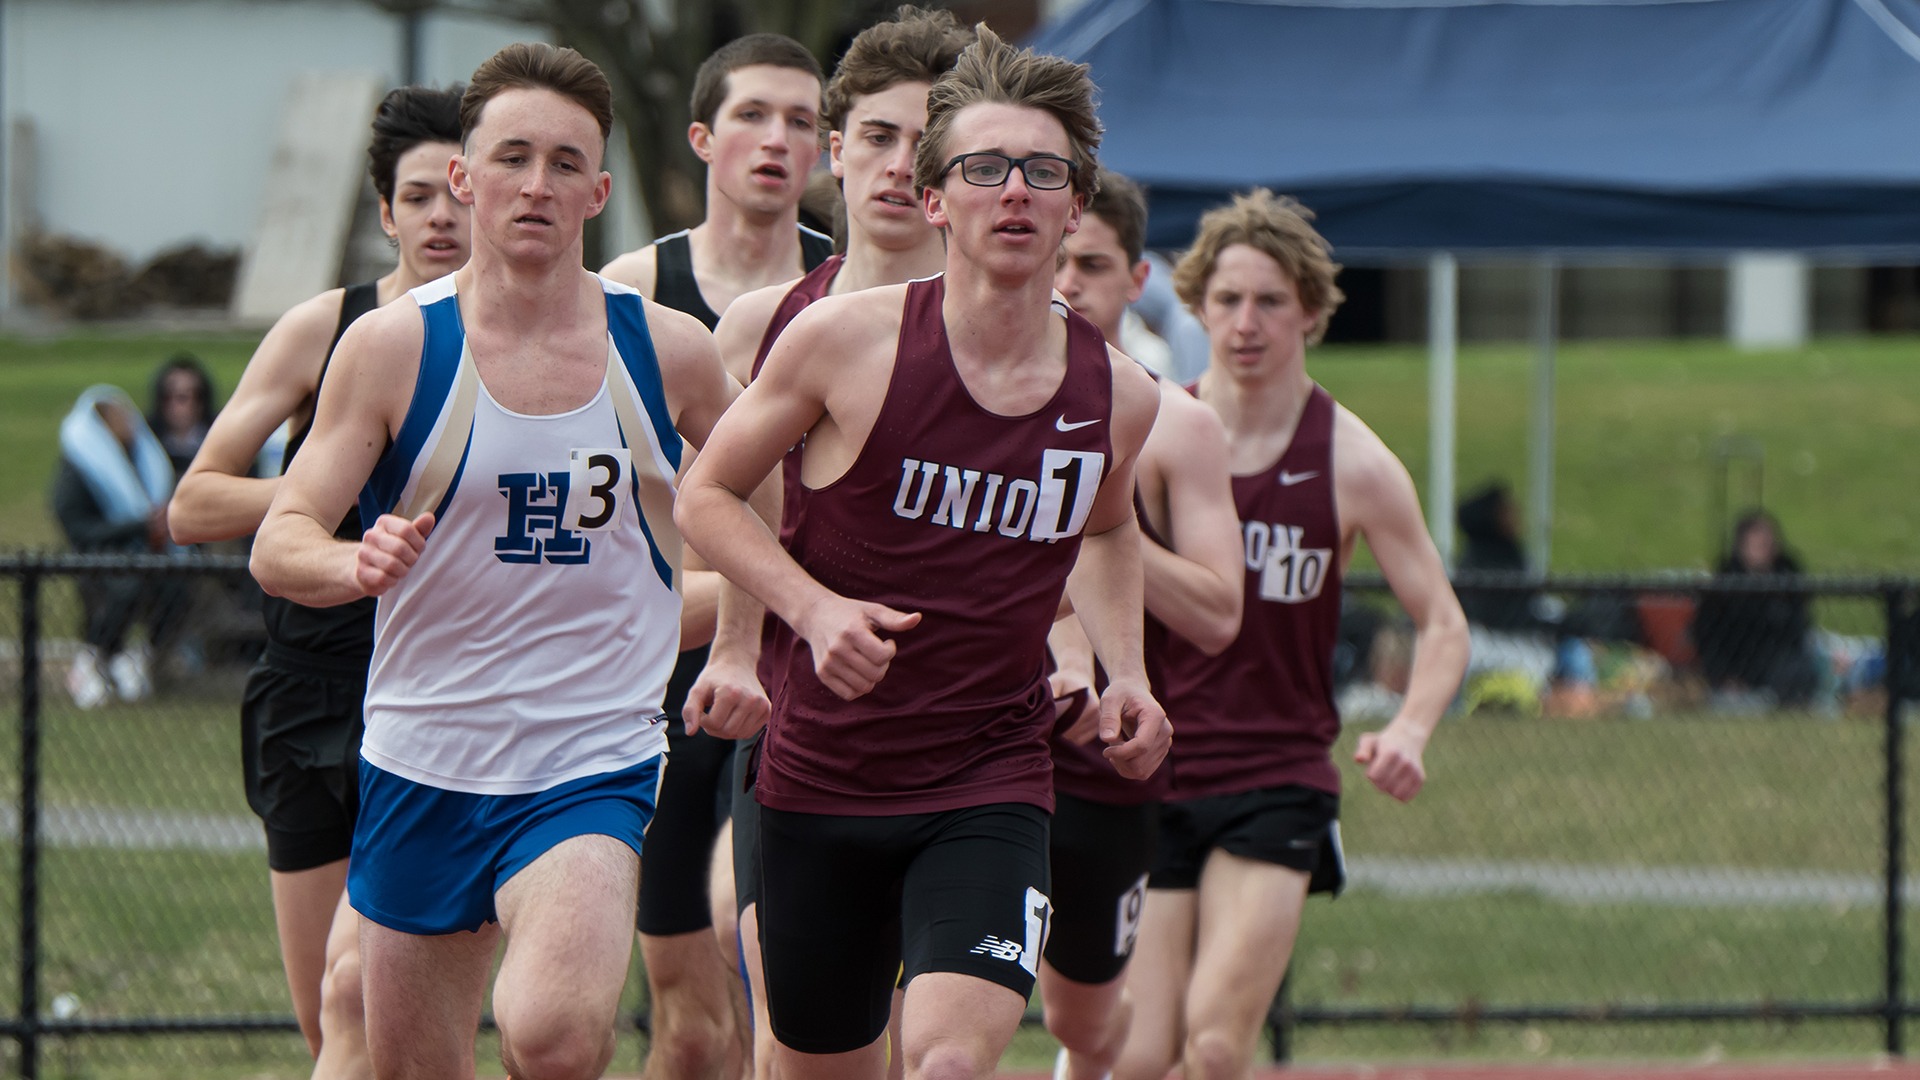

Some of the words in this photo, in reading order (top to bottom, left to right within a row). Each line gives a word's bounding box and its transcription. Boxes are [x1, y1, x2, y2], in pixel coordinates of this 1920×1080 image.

[494, 472, 591, 565] H
[578, 454, 621, 529] 3
[893, 458, 1059, 544] UNIO
[1052, 457, 1082, 533] 1
[1240, 520, 1304, 573] ON
[1280, 551, 1322, 598] 10
